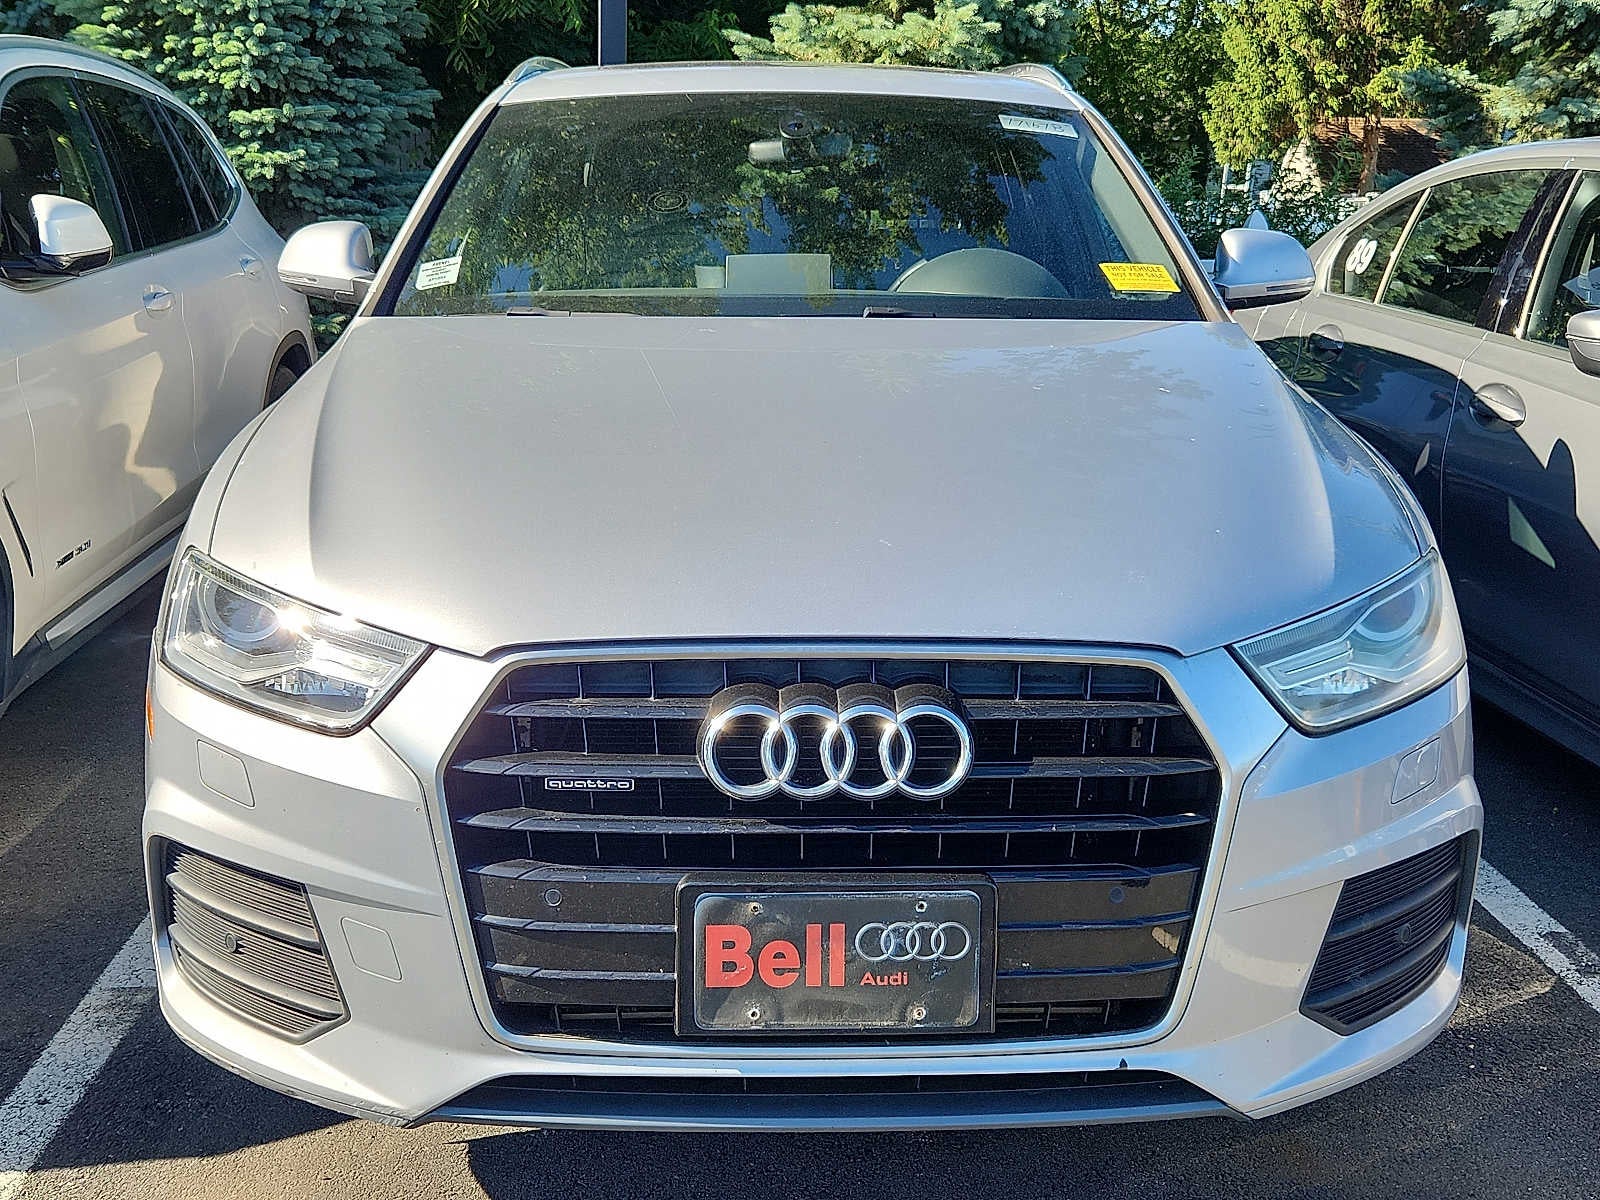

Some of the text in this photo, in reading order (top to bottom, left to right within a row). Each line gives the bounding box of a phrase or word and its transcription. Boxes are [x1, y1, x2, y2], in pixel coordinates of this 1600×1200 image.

[1345, 238, 1378, 275] 89
[1126, 265, 1162, 273] VEHICLE
[548, 779, 630, 789] quattro
[705, 923, 846, 988] Bell
[860, 970, 908, 986] Audi
